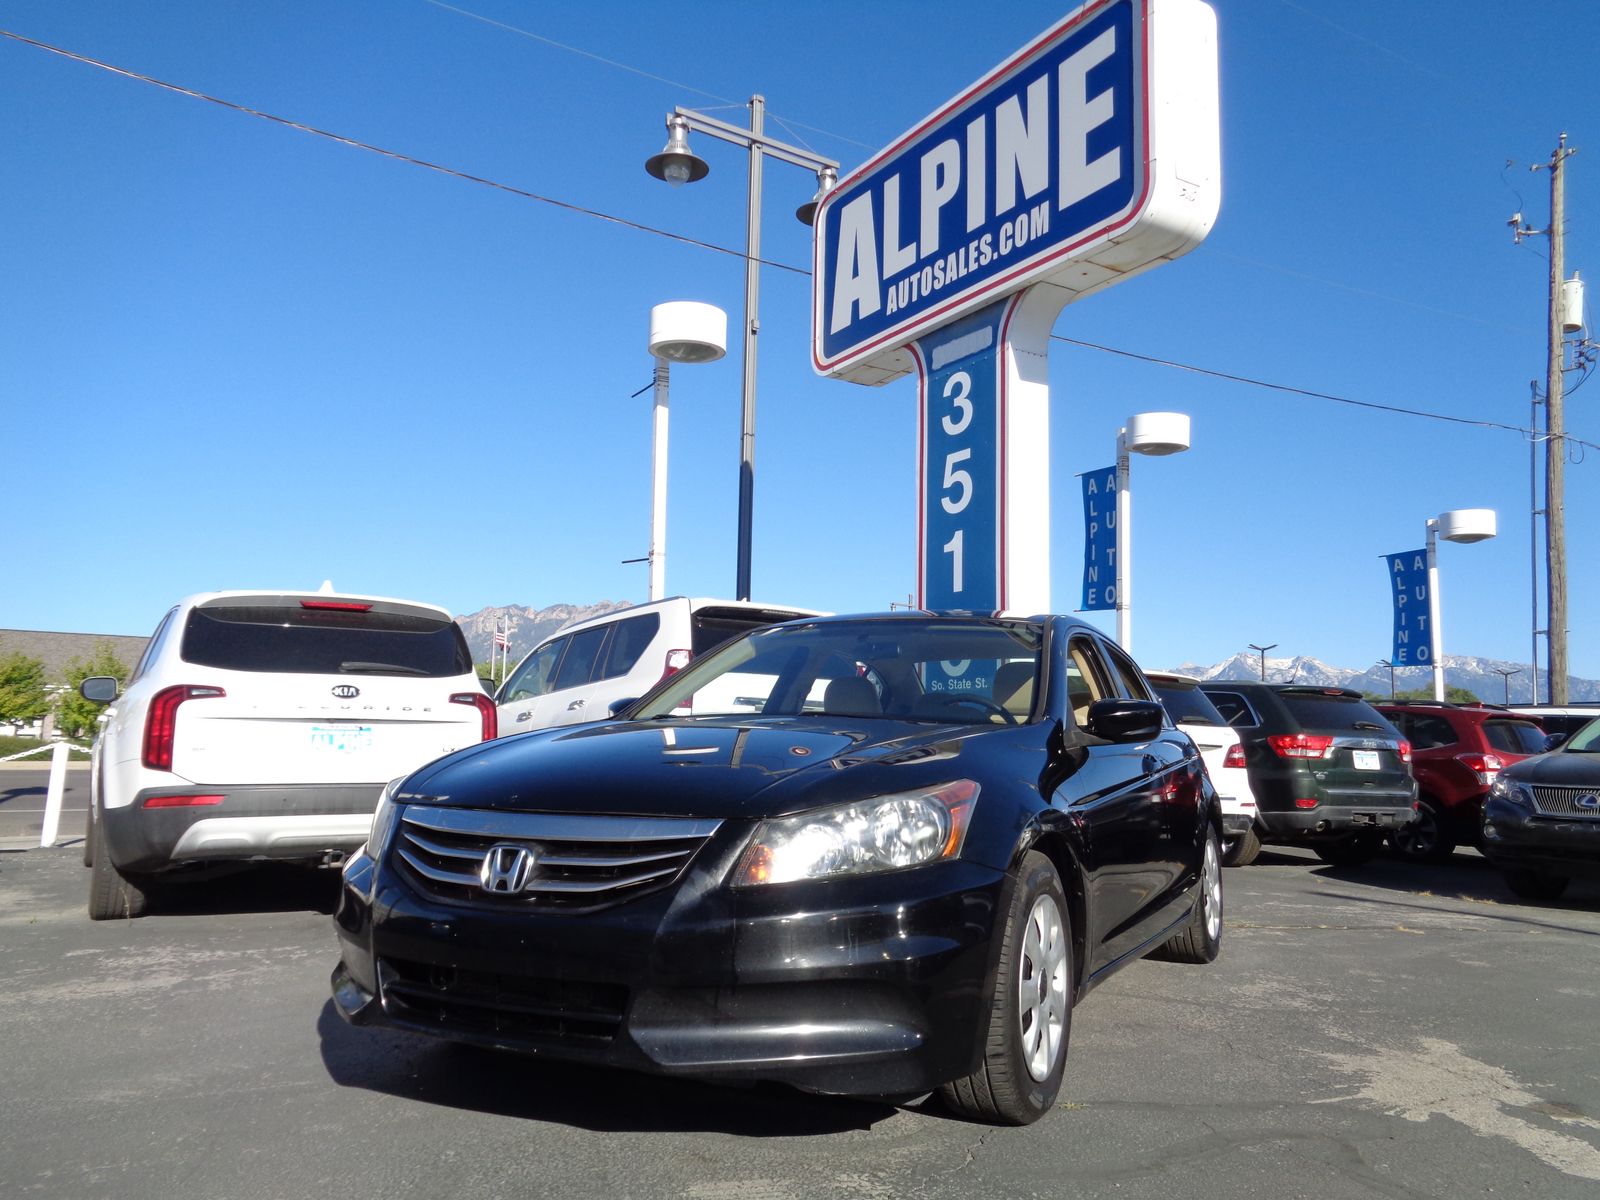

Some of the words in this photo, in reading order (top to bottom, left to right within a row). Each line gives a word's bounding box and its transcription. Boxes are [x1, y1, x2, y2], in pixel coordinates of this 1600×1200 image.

[830, 25, 1121, 335] ALPINE
[886, 200, 1050, 316] AUTOSALES.COM
[1087, 478, 1098, 605] ALPINE
[1104, 474, 1117, 604] AUTO
[1393, 558, 1409, 662] ALPINE
[1413, 555, 1429, 661] AUTO
[332, 686, 358, 697] KIA
[931, 680, 945, 691] So.
[948, 678, 972, 690] State
[975, 677, 988, 688] St.
